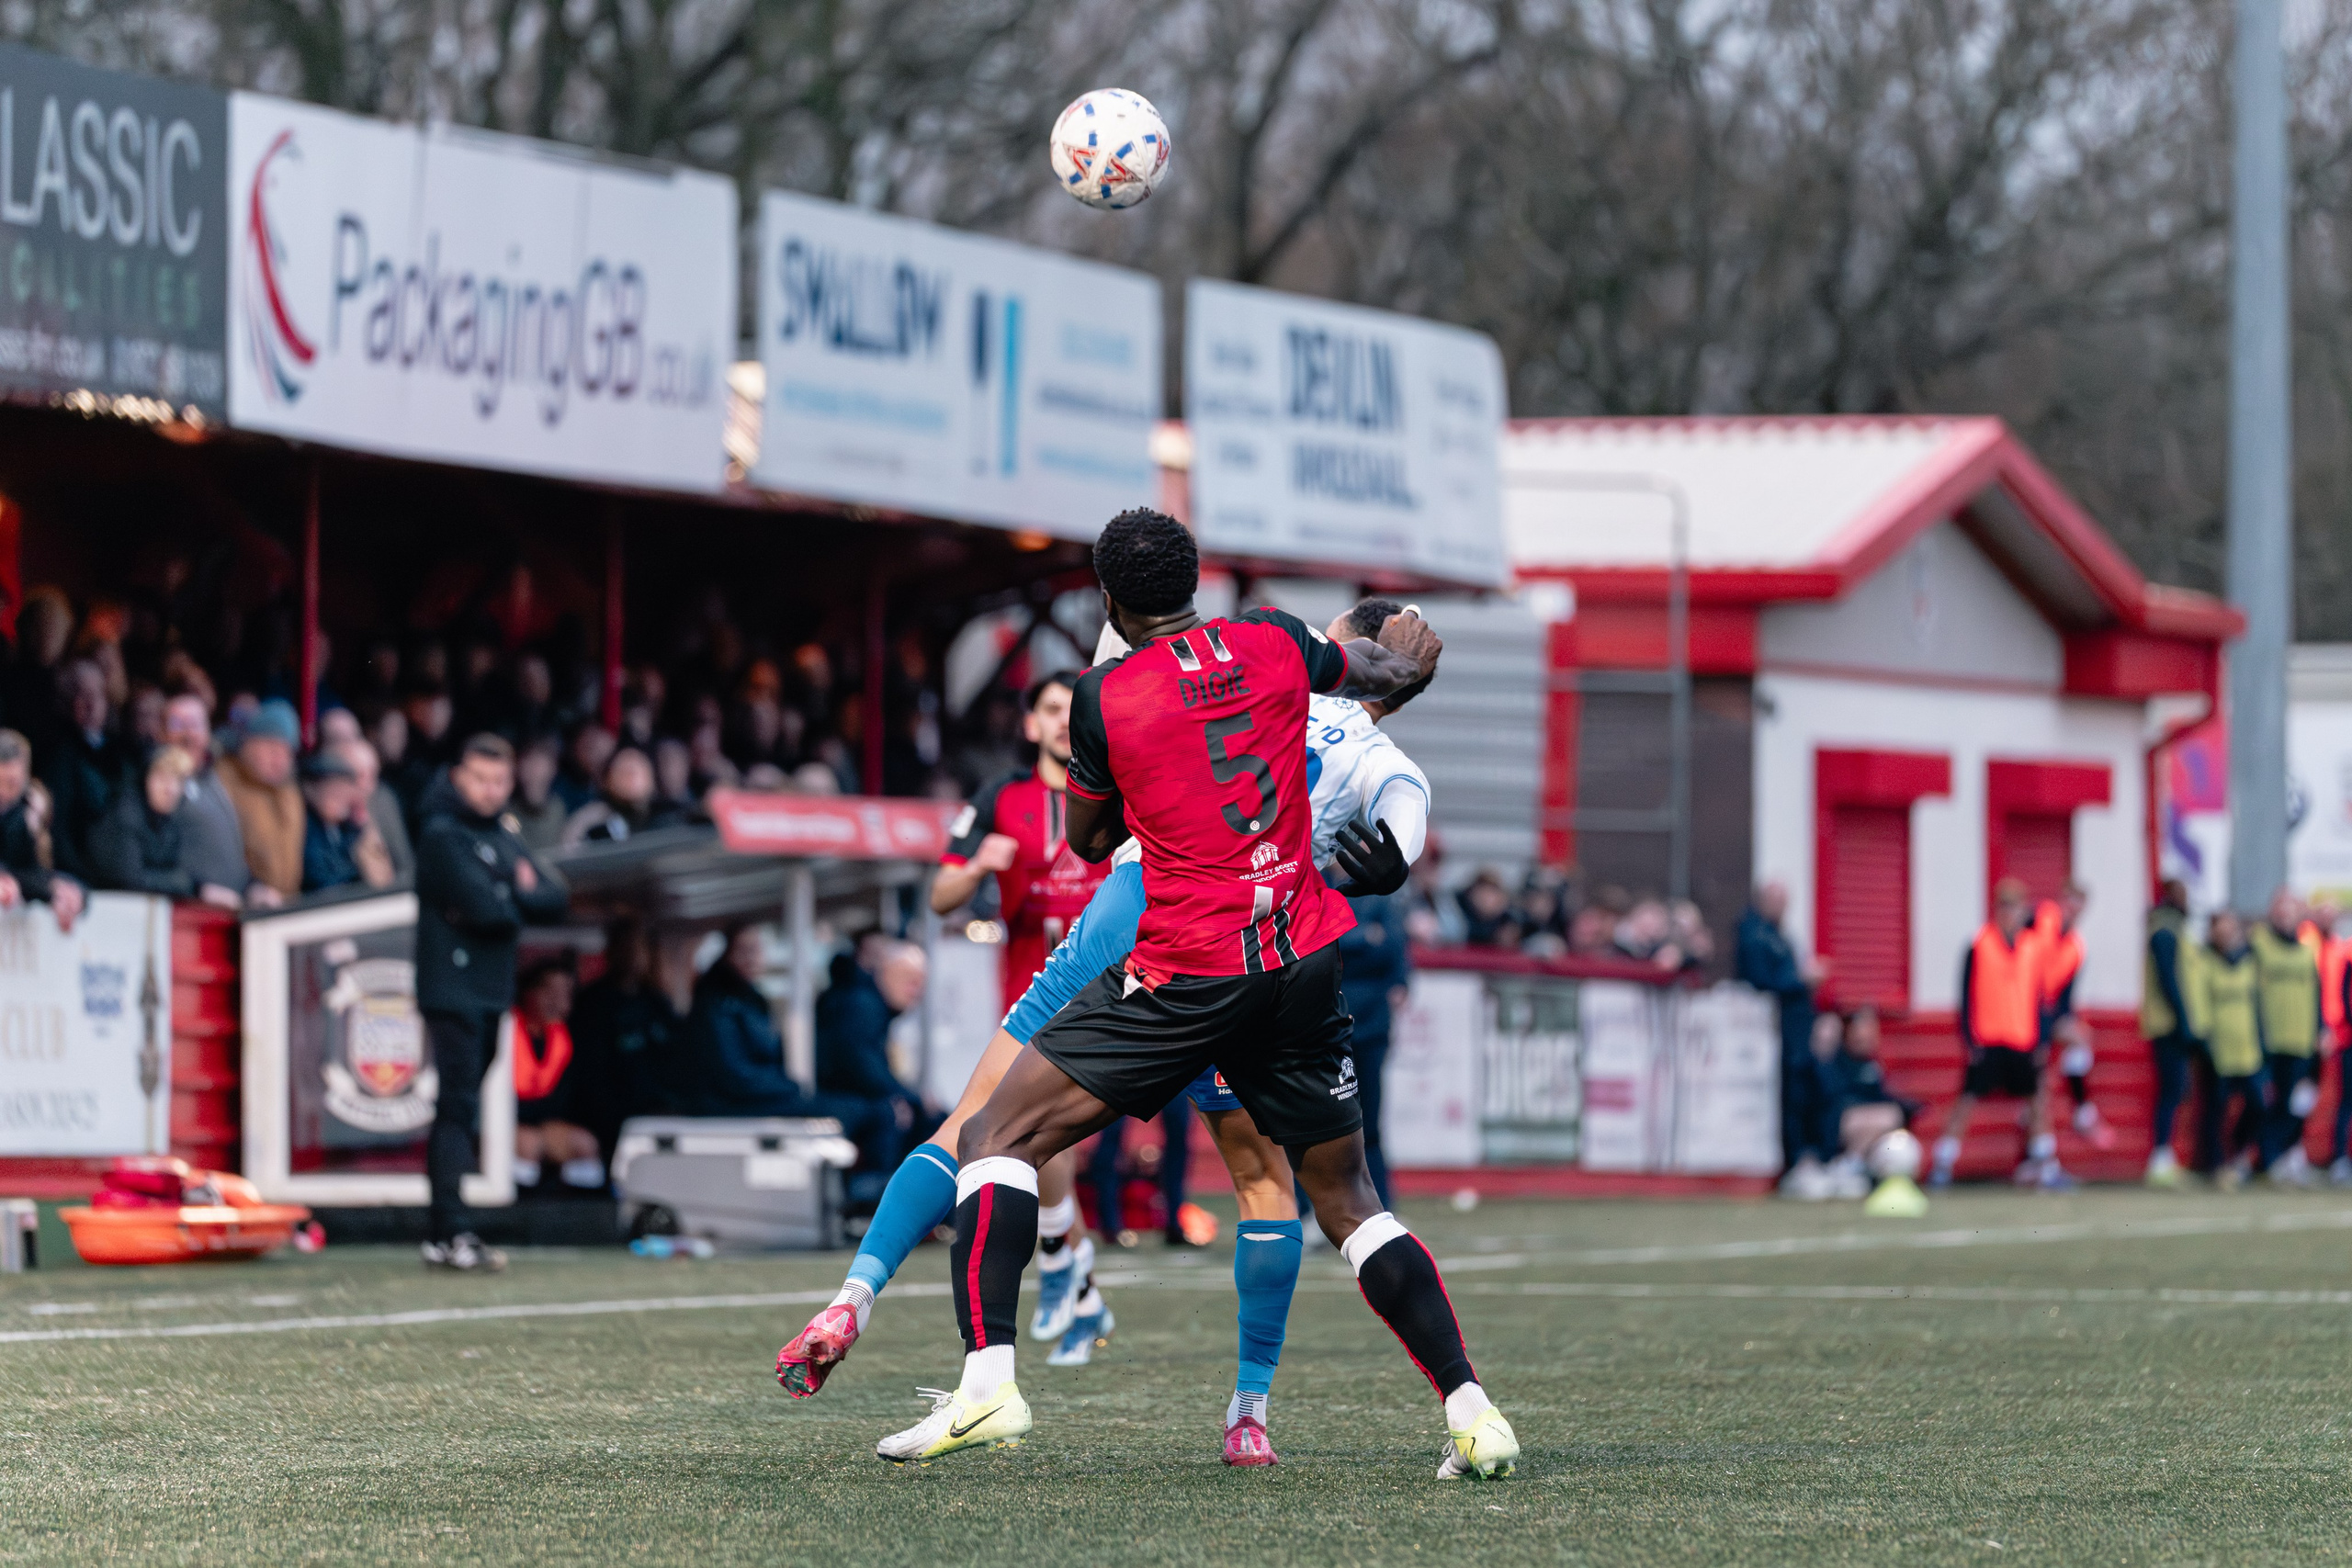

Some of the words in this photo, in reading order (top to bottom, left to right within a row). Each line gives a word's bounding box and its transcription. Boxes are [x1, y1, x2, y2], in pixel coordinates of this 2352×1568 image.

[1178, 665, 1251, 708] DIGIE
[1204, 711, 1278, 836] 5
[1239, 868, 1273, 880] BRADLEY
